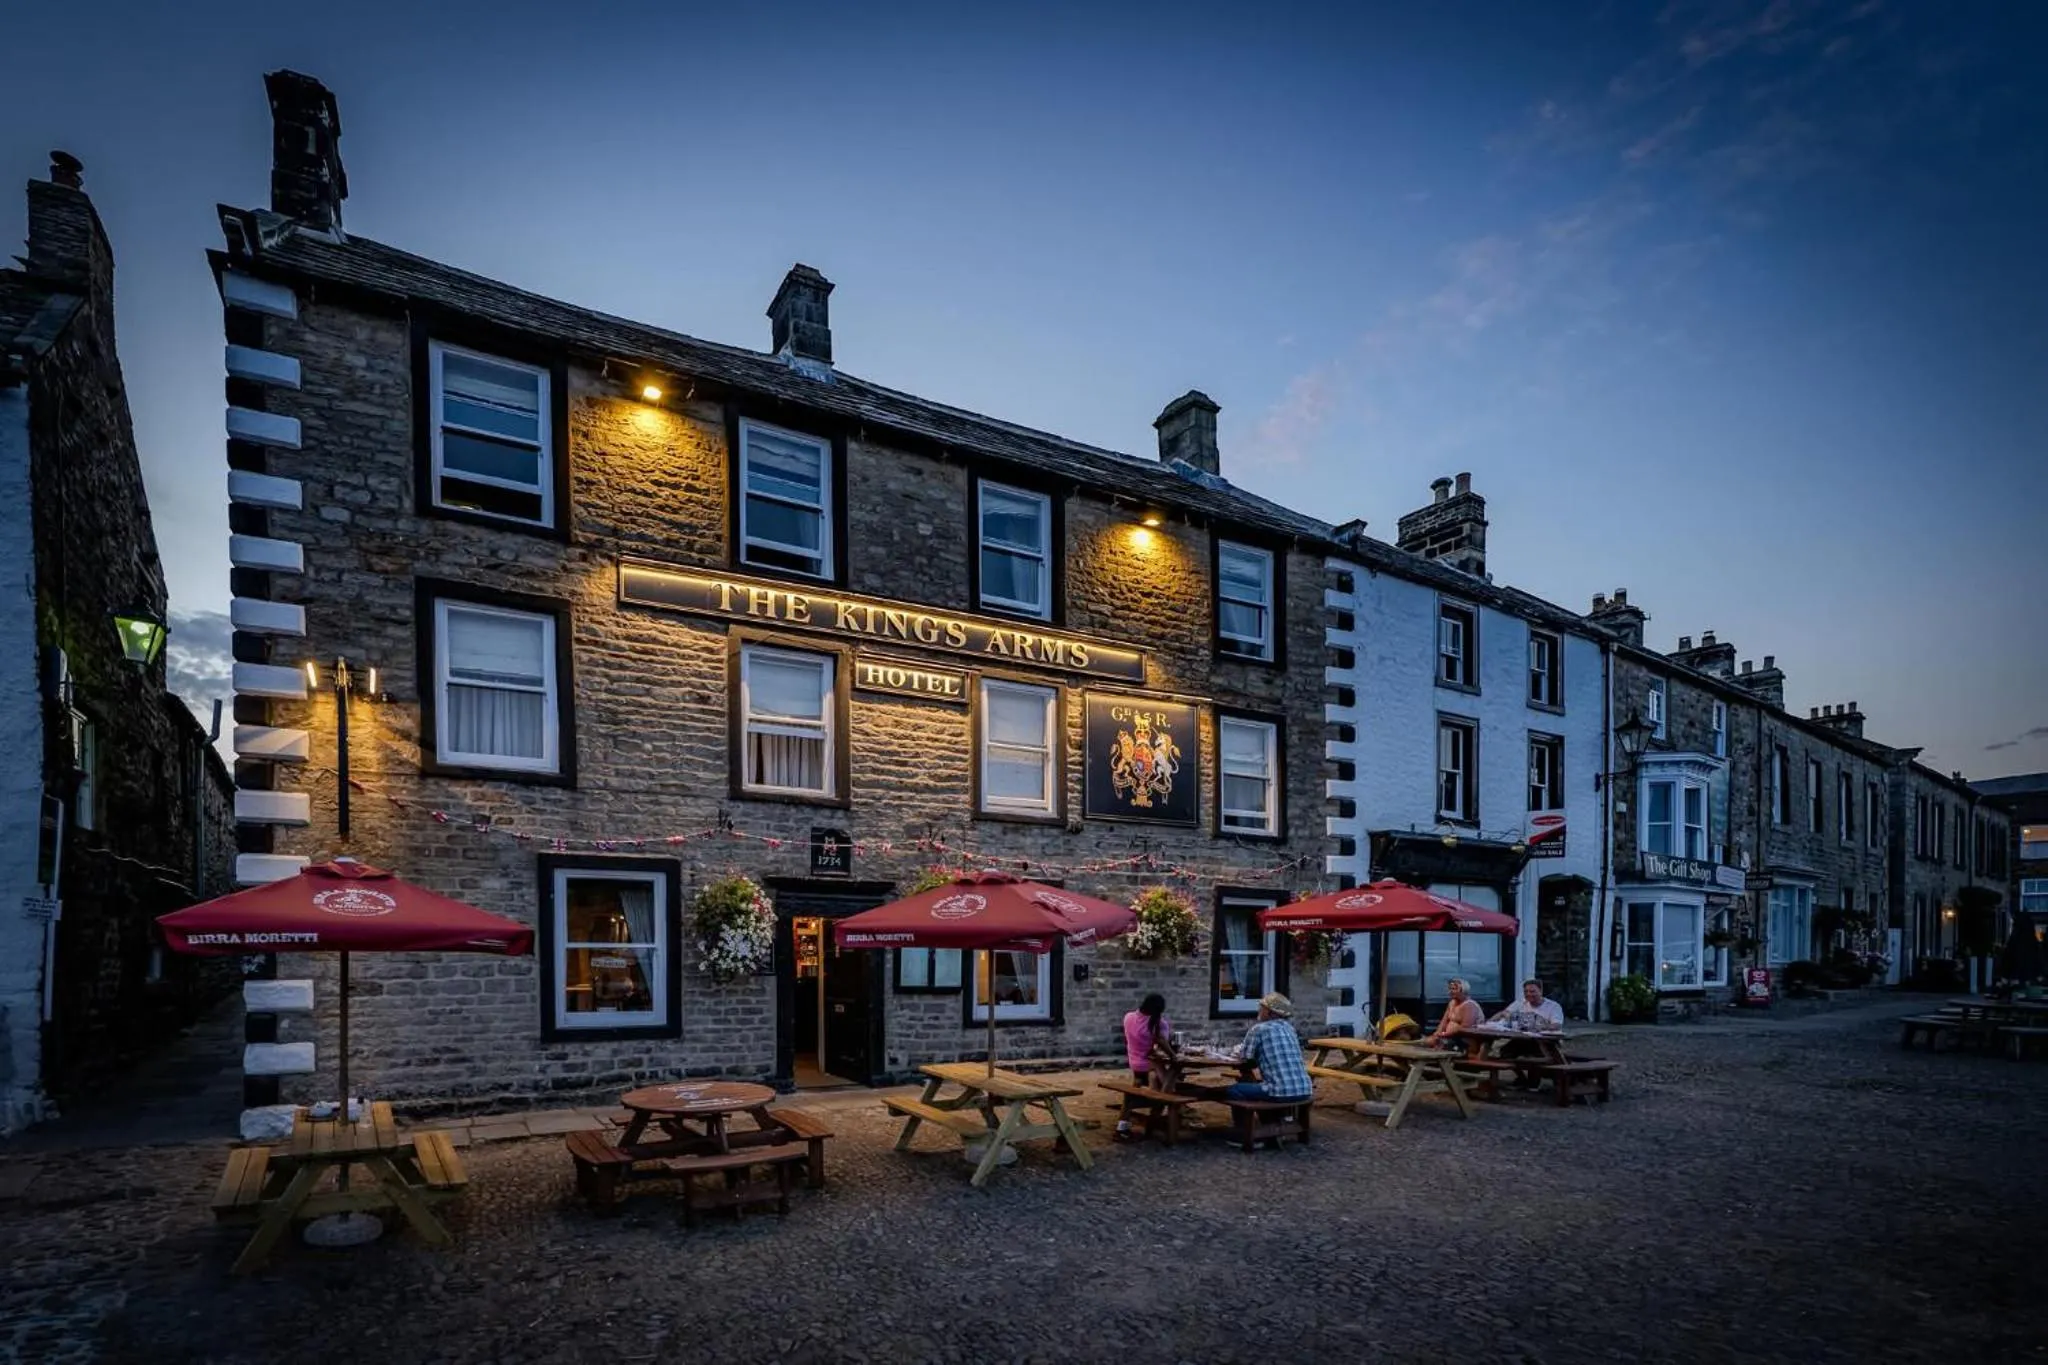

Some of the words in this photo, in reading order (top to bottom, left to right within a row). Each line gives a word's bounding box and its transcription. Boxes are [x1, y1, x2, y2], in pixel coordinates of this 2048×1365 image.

[711, 582, 812, 624] THE
[834, 601, 967, 648] KINGS
[985, 628, 1090, 668] ARMS
[866, 664, 960, 696] HOTEL
[1648, 856, 1668, 875] The
[1669, 859, 1687, 878] Gift
[1689, 862, 1712, 881] Shop
[187, 933, 241, 944] BIRRA
[244, 932, 319, 943] MORETTI
